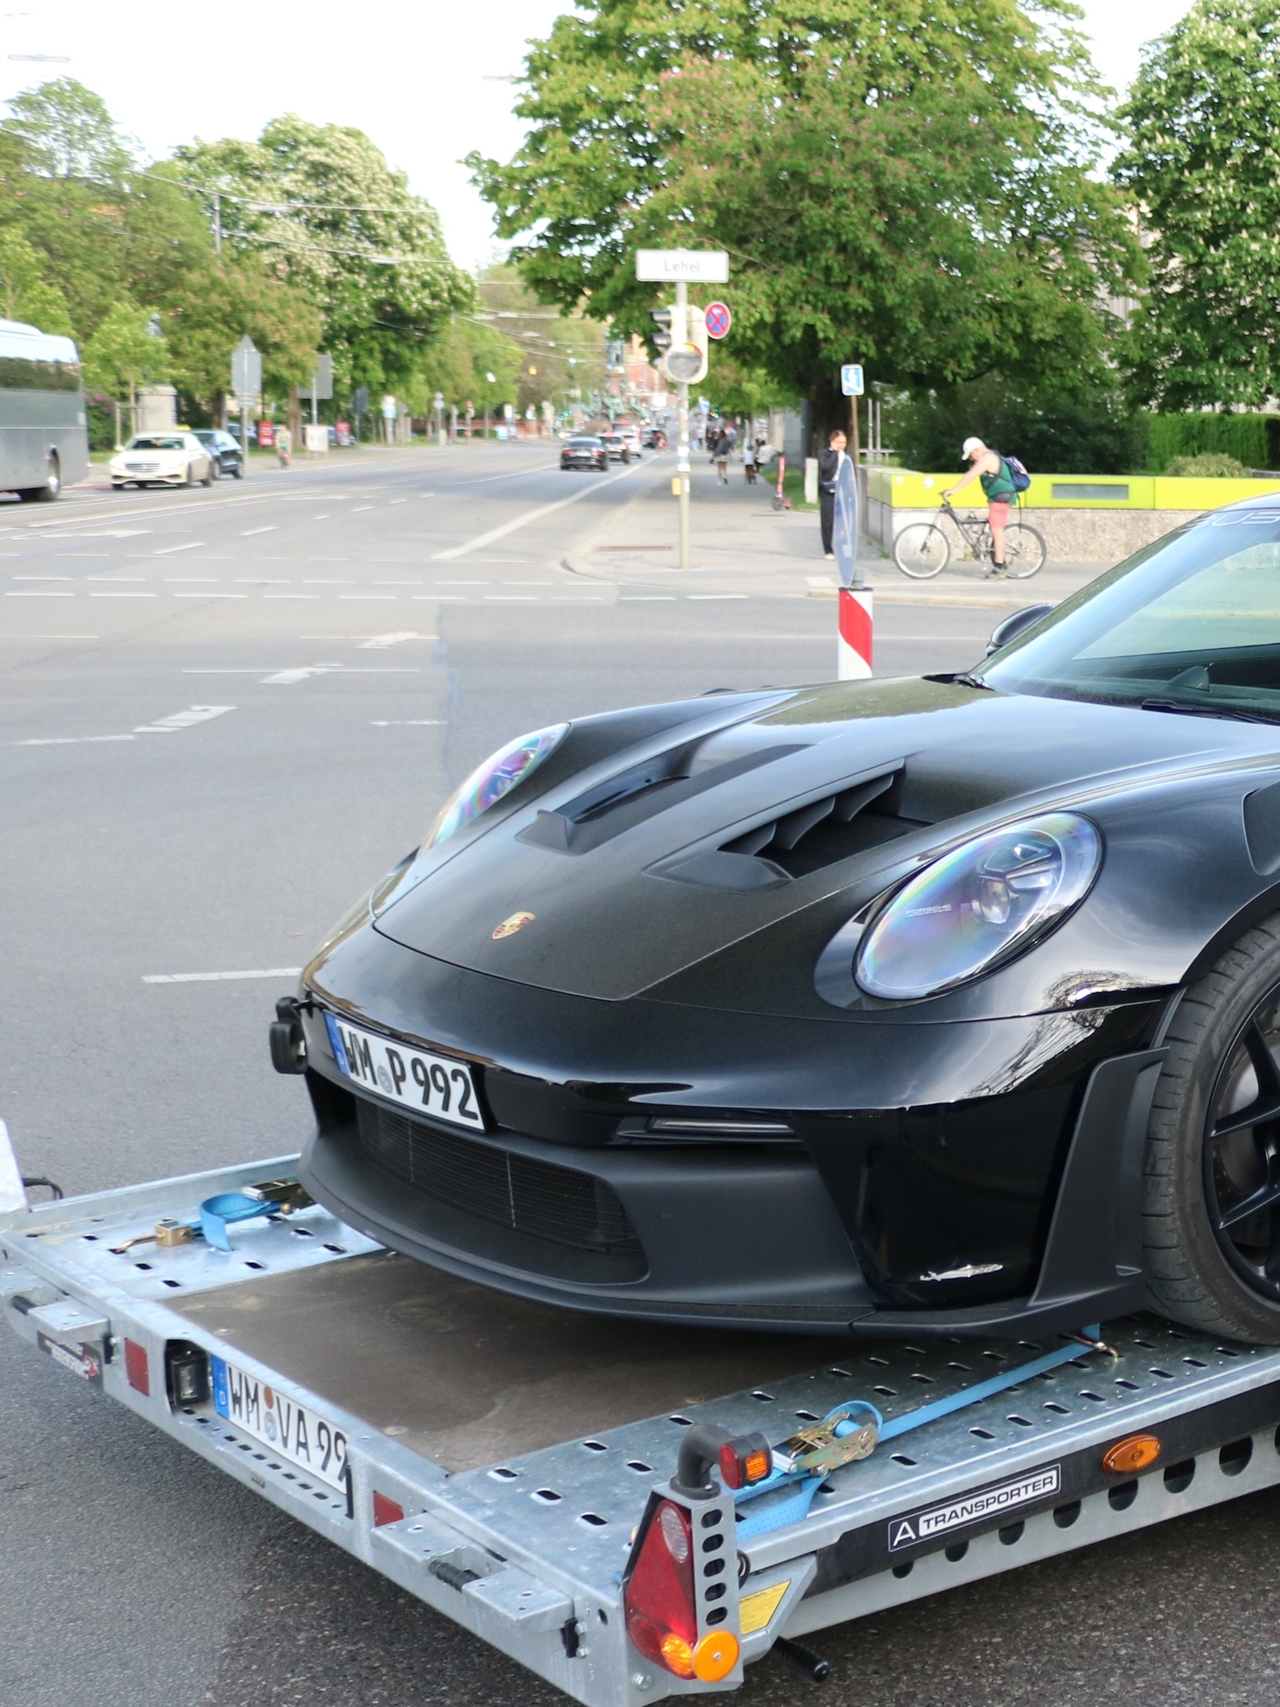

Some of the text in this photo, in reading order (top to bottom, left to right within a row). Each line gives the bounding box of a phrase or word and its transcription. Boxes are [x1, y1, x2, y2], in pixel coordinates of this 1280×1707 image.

[664, 260, 700, 272] Lehel
[338, 1026, 479, 1121] WM P 992
[228, 1366, 261, 1432] WM
[275, 1395, 311, 1463] VA
[892, 1475, 1054, 1547] A TRANSPORTER
